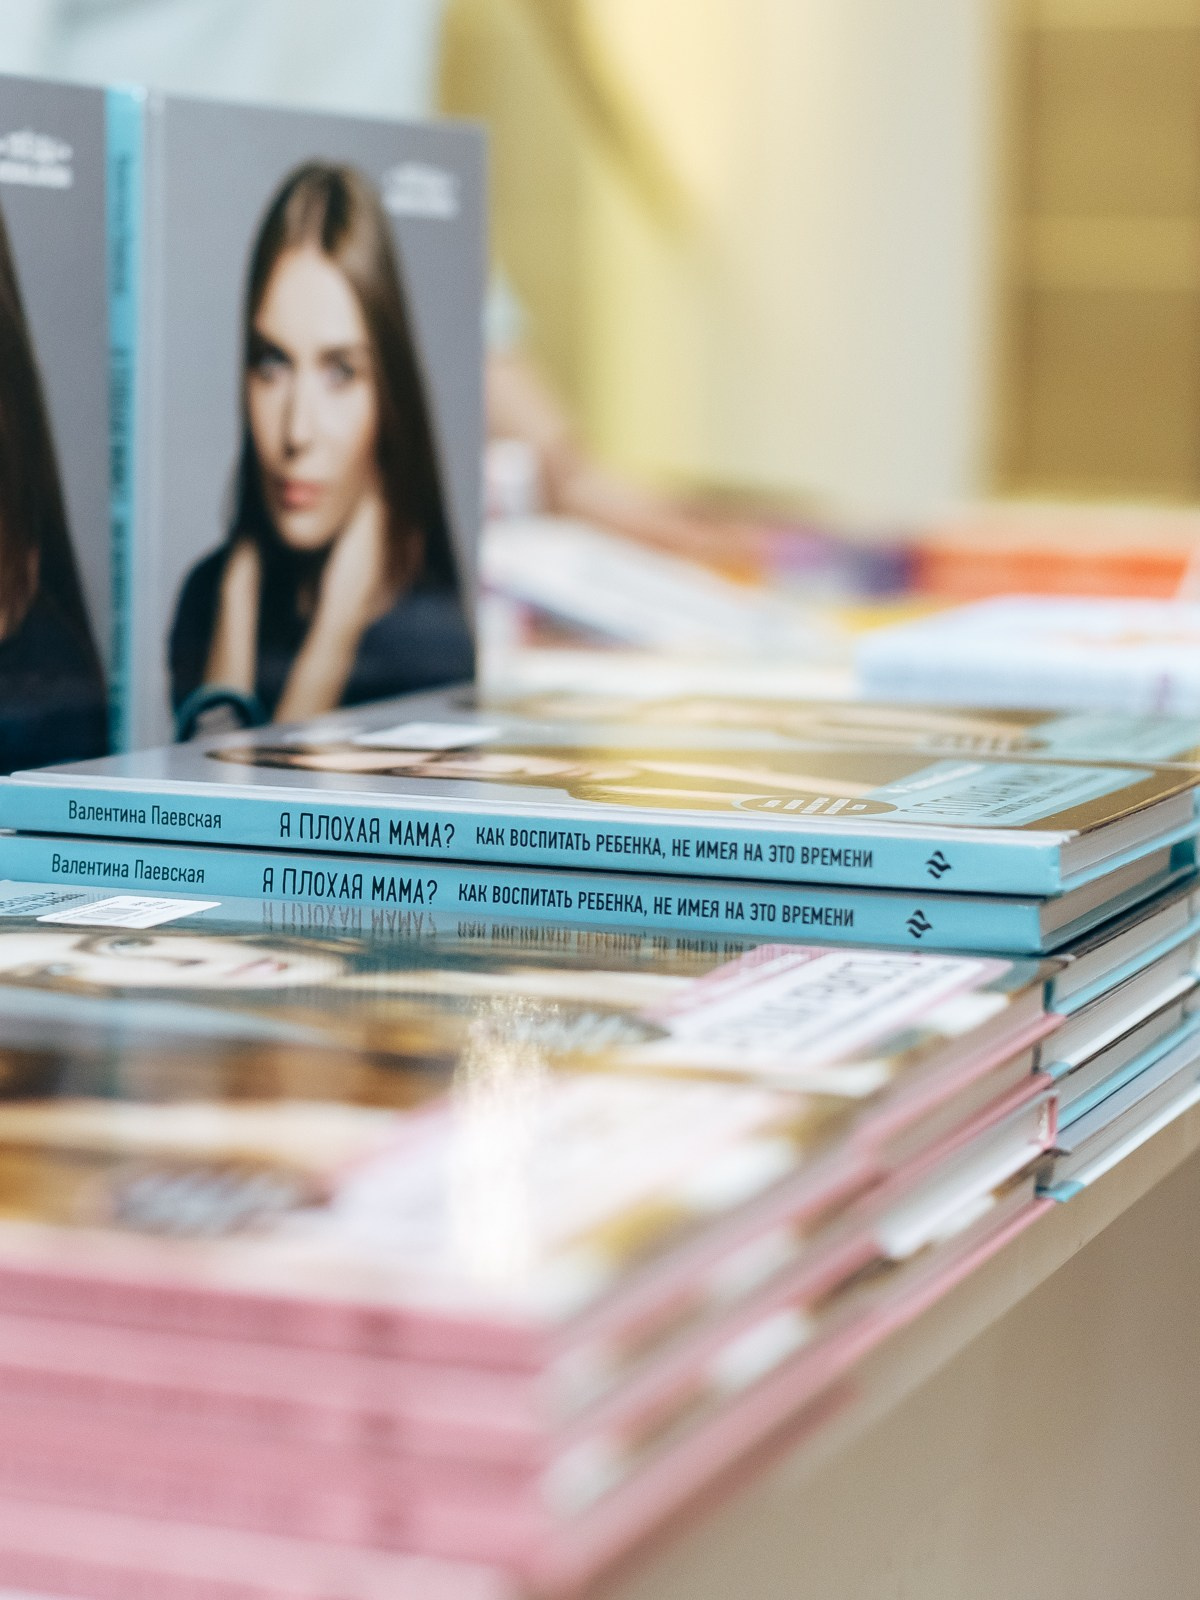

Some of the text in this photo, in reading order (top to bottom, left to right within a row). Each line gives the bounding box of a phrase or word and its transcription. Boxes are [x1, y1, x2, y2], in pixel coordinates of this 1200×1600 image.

[68, 800, 222, 829] Валентина Паевская
[279, 812, 455, 848] Я ПЛОХАЯ МАМА?
[476, 826, 873, 868] КАК ВОСПИТАТЬ РЕБЕНКА, НЕ ИМЕЯ НА ЭТО ВРЕМЕНИ
[51, 853, 205, 883] Валентина Паевская
[263, 867, 438, 905] Я ПЛОХАЯ МАМА?
[458, 883, 855, 927] КАК ВОСПИТАТЬ РЕБЕНКА, НЕ ИМЕЯ НА ЭТО ВРЕМЕНИ
